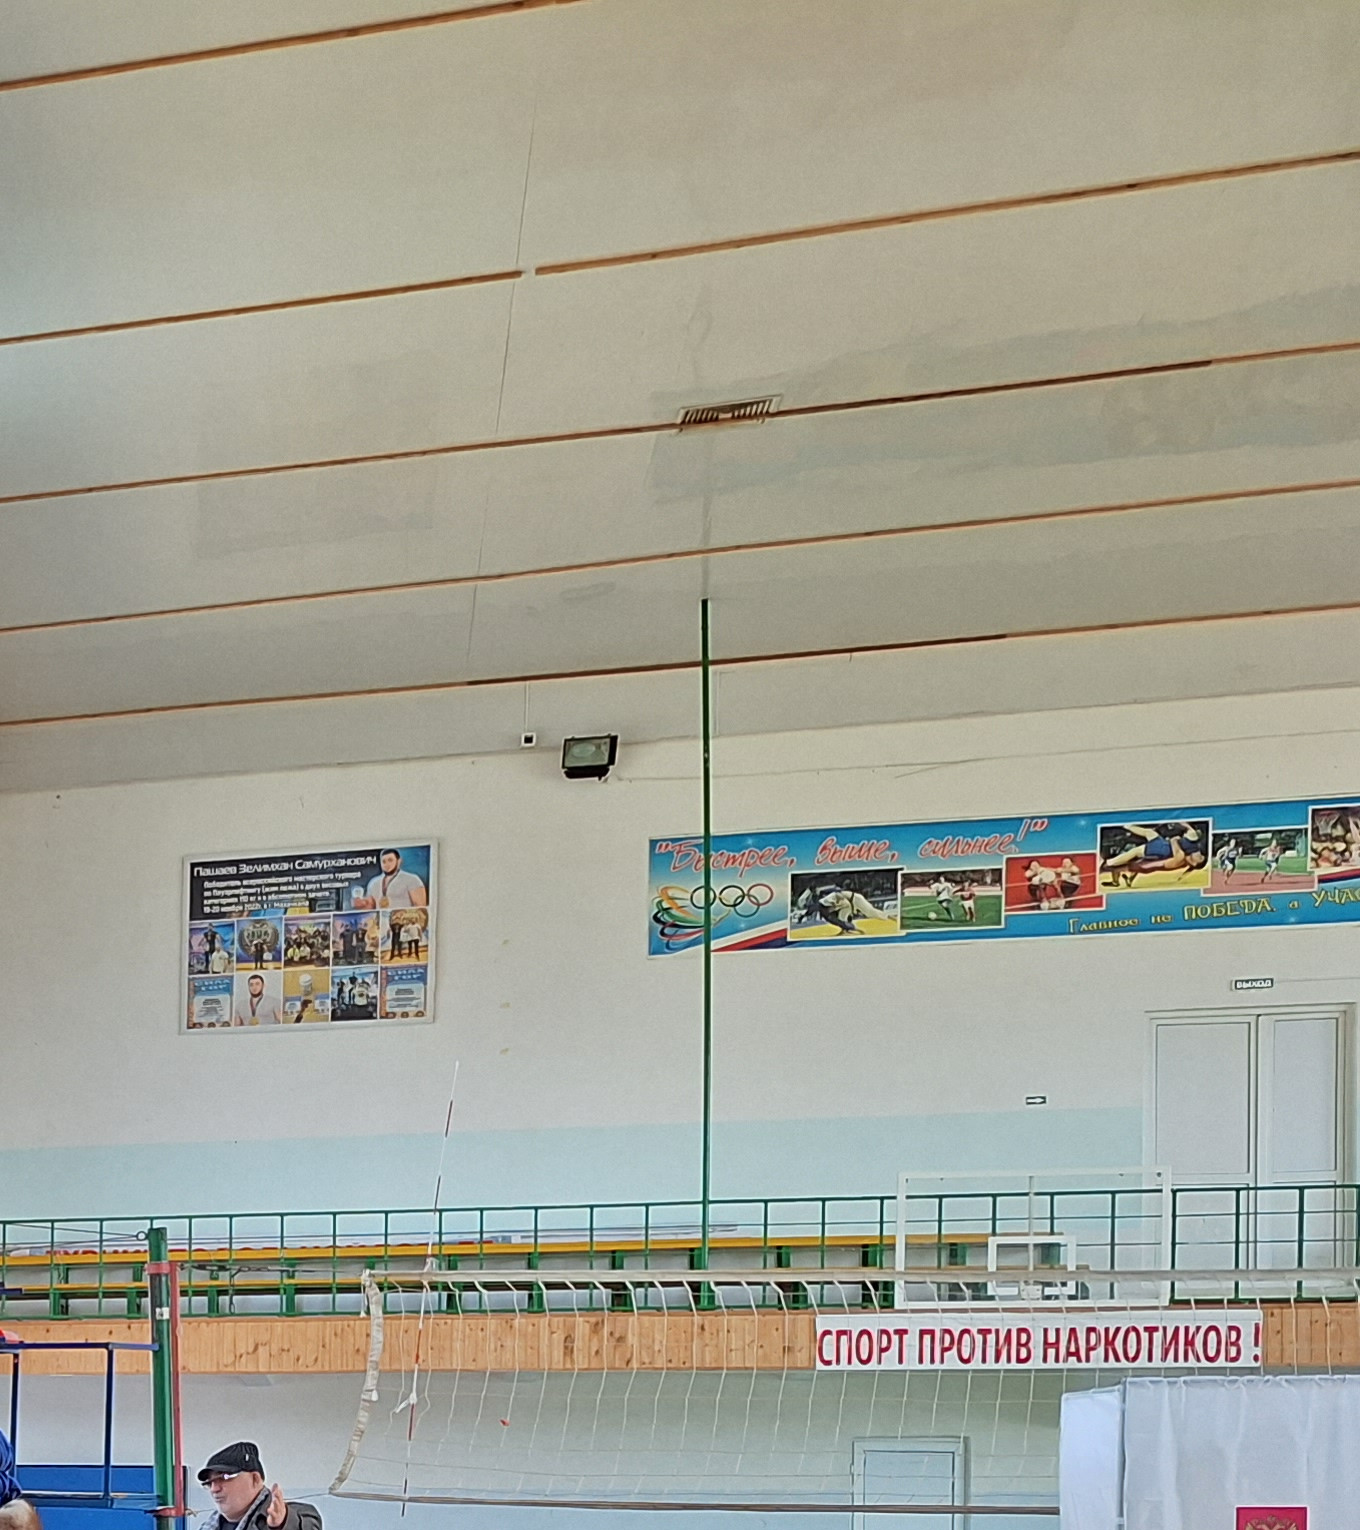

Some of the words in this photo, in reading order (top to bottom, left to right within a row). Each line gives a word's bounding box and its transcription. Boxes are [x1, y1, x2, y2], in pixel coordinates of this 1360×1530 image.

[1235, 978, 1272, 988] ВЫХОД
[817, 1328, 909, 1366] СПОРТ
[917, 1326, 1032, 1365] ПРОТИВ
[1041, 1324, 1243, 1365] НАРКОТИКОВ
